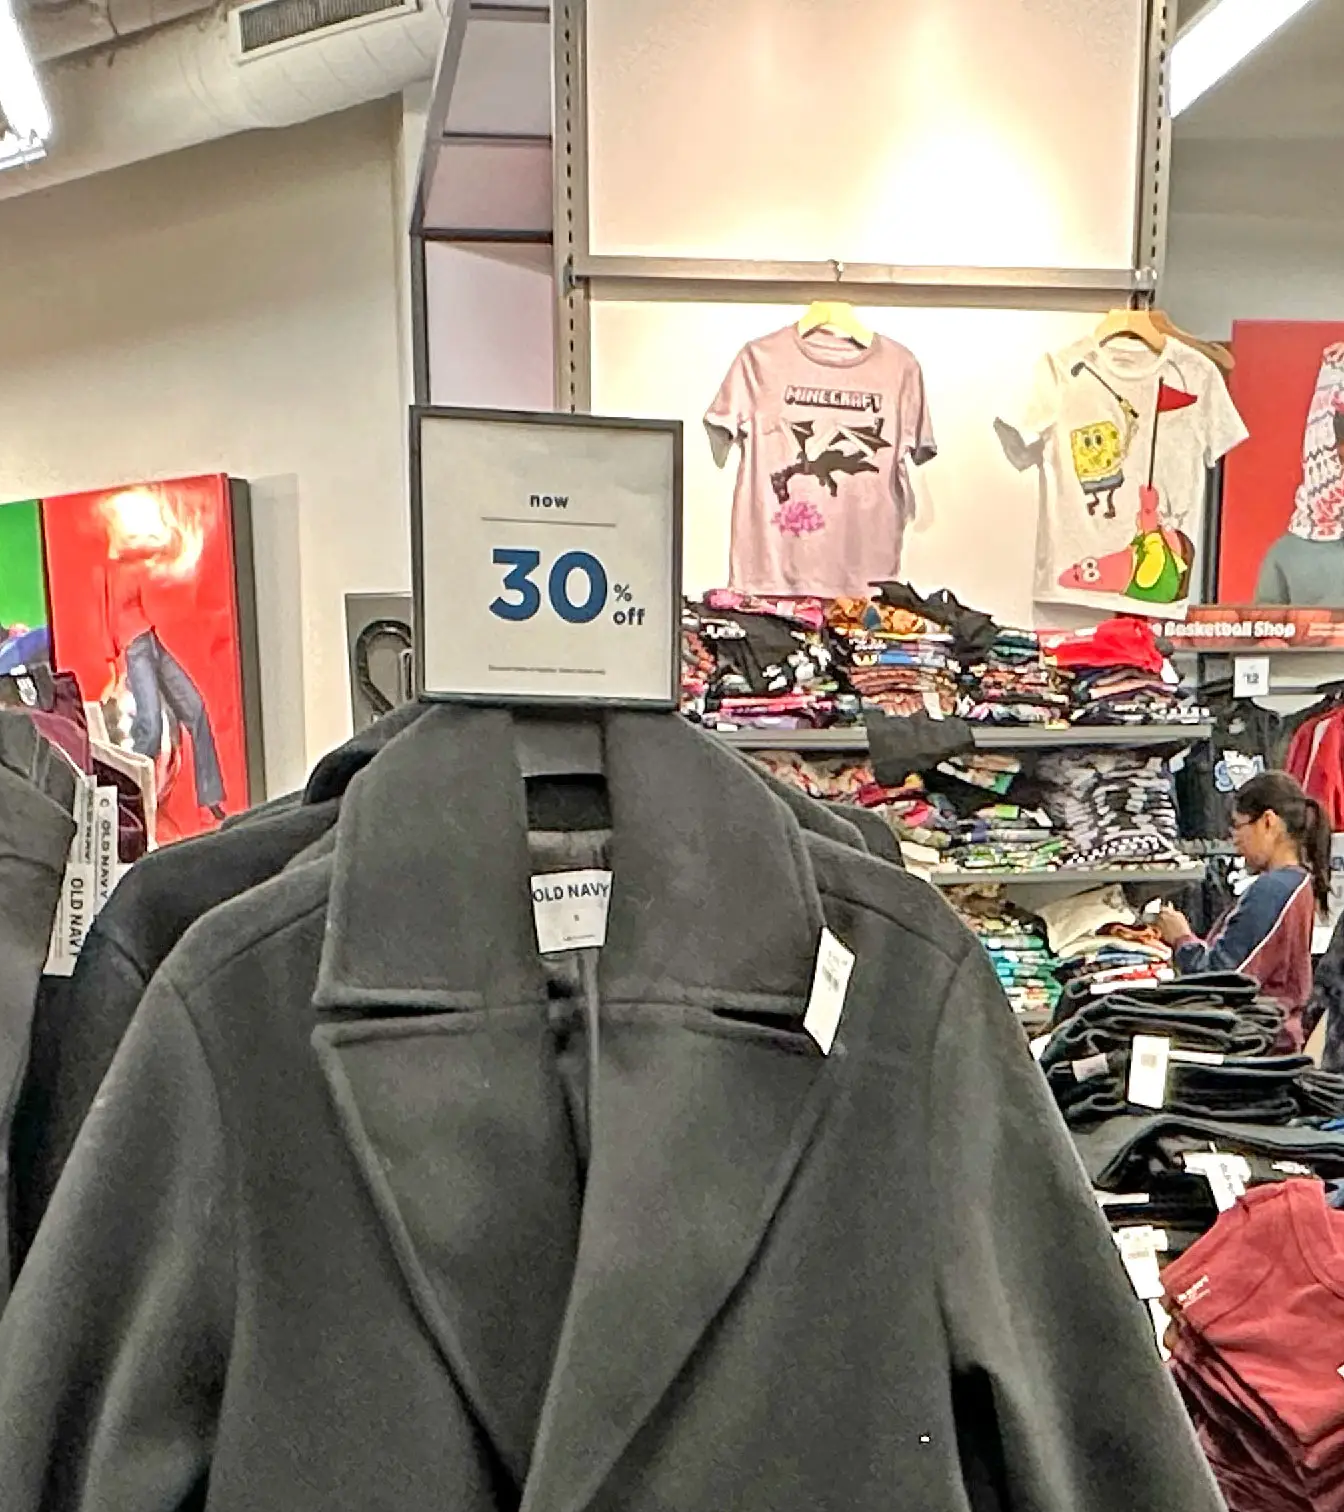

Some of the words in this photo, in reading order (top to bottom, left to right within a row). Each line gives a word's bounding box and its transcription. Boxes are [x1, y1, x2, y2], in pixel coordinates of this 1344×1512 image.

[785, 385, 883, 413] MINECRAFT
[529, 494, 569, 509] now
[489, 548, 608, 624] 30
[612, 607, 646, 626] off
[1164, 620, 1251, 638] Basketball
[1254, 620, 1296, 639] Shop
[70, 878, 84, 910] OLD
[532, 886, 564, 903] OLD
[567, 882, 610, 899] NAVY
